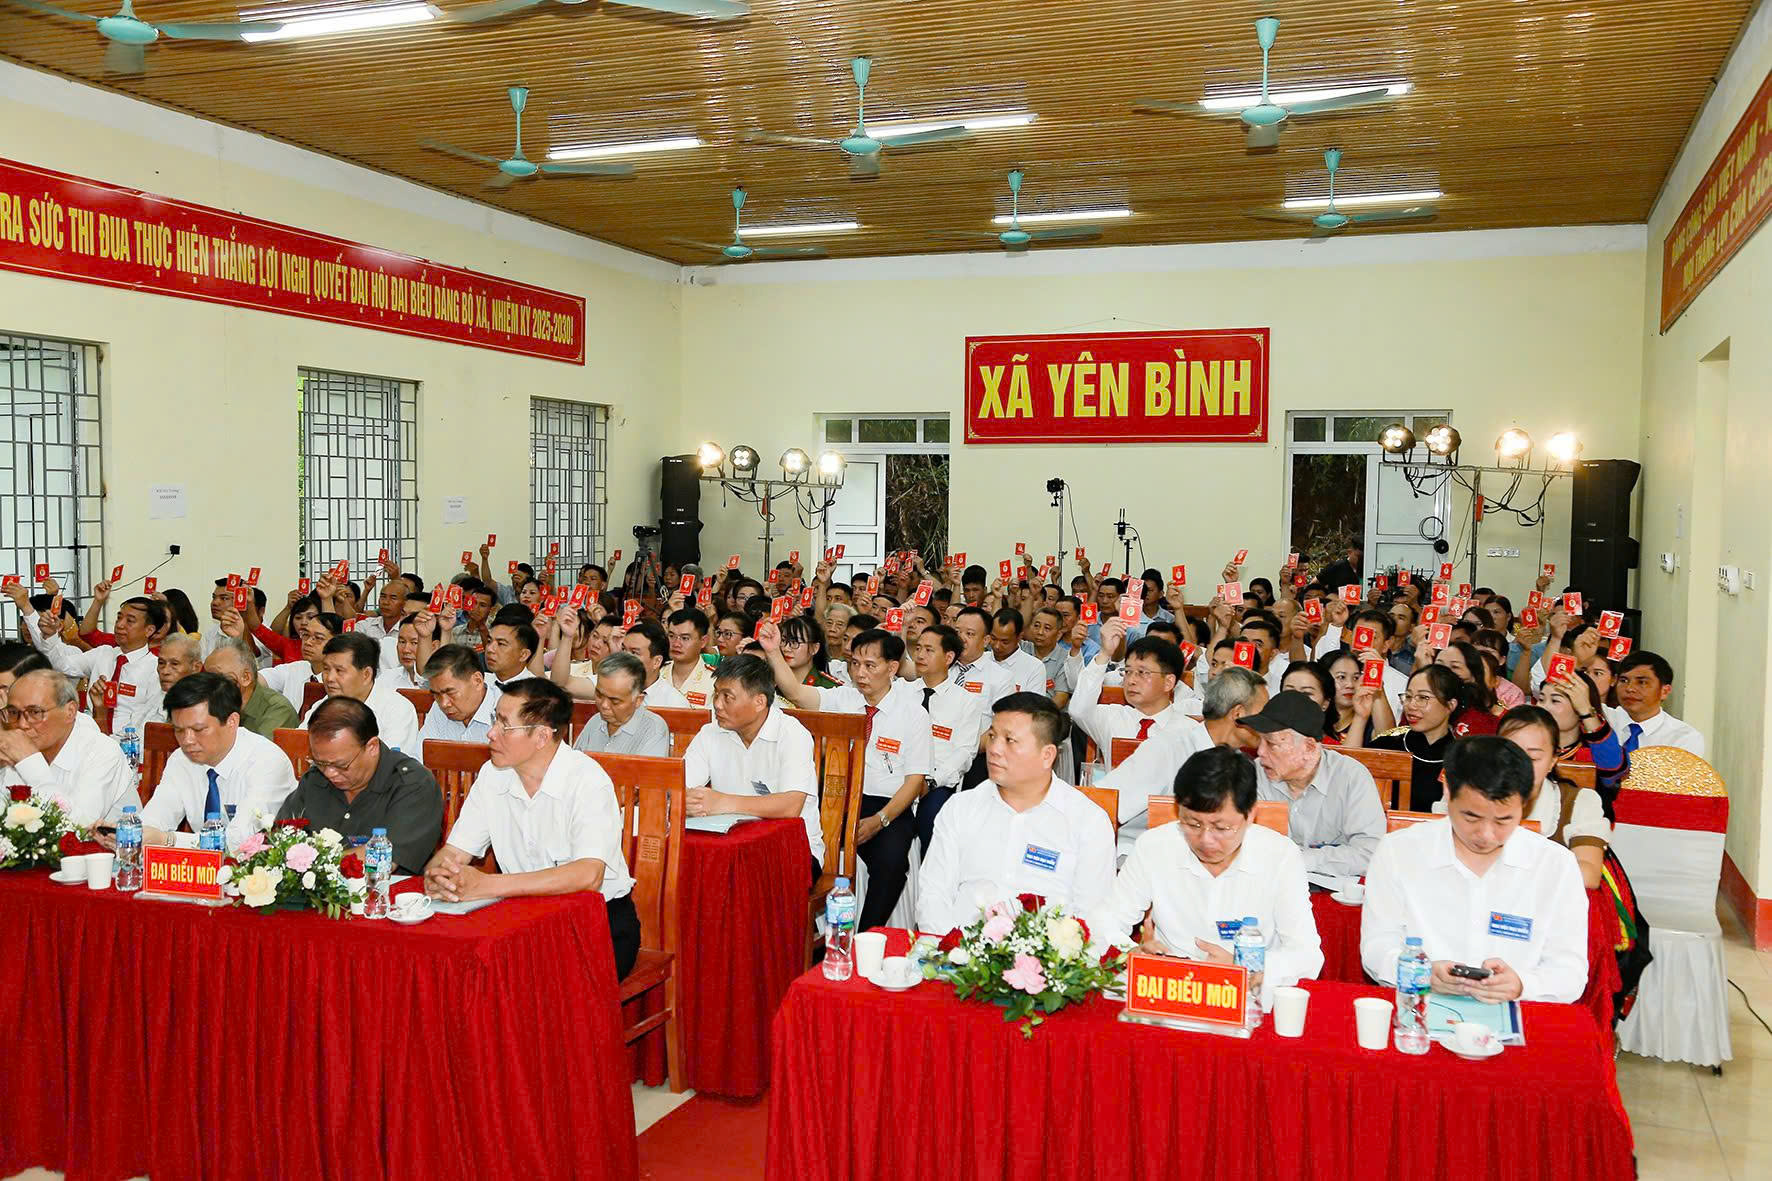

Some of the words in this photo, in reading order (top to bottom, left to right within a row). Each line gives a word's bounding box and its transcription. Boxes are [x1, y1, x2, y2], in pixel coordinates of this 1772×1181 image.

[0, 192, 24, 243] RA
[29, 191, 64, 250] SỨC
[68, 207, 95, 256] THI
[98, 213, 131, 262] ĐUA
[133, 221, 173, 278] THỰC
[176, 224, 210, 284] HIỆN
[212, 225, 256, 285] THẮNG
[258, 244, 279, 297] LỢI
[281, 252, 311, 304] NGHỊ
[313, 253, 349, 302] QUYẾT
[350, 267, 369, 314] ĐẠI
[371, 266, 389, 317] HỘI
[391, 276, 408, 320] ĐẠI
[410, 269, 432, 319] BIỂU
[434, 275, 460, 324] ĐẢNG
[461, 286, 474, 334] BỘ
[476, 290, 490, 334] XÃ,
[491, 295, 519, 341] NHIỆM
[520, 299, 531, 337] KỲ
[532, 308, 574, 345] 2025-2030!
[977, 353, 1033, 418] XÃ
[1047, 351, 1129, 417] YÊN
[1145, 349, 1251, 417] BÌNH
[151, 862, 168, 884] ĐẠI
[170, 857, 194, 883] BIỂU
[196, 862, 217, 885] MỜI
[1137, 974, 1163, 1003] ĐẠI
[1167, 971, 1202, 1004] BIỂU
[1206, 979, 1238, 1009] MỜI
